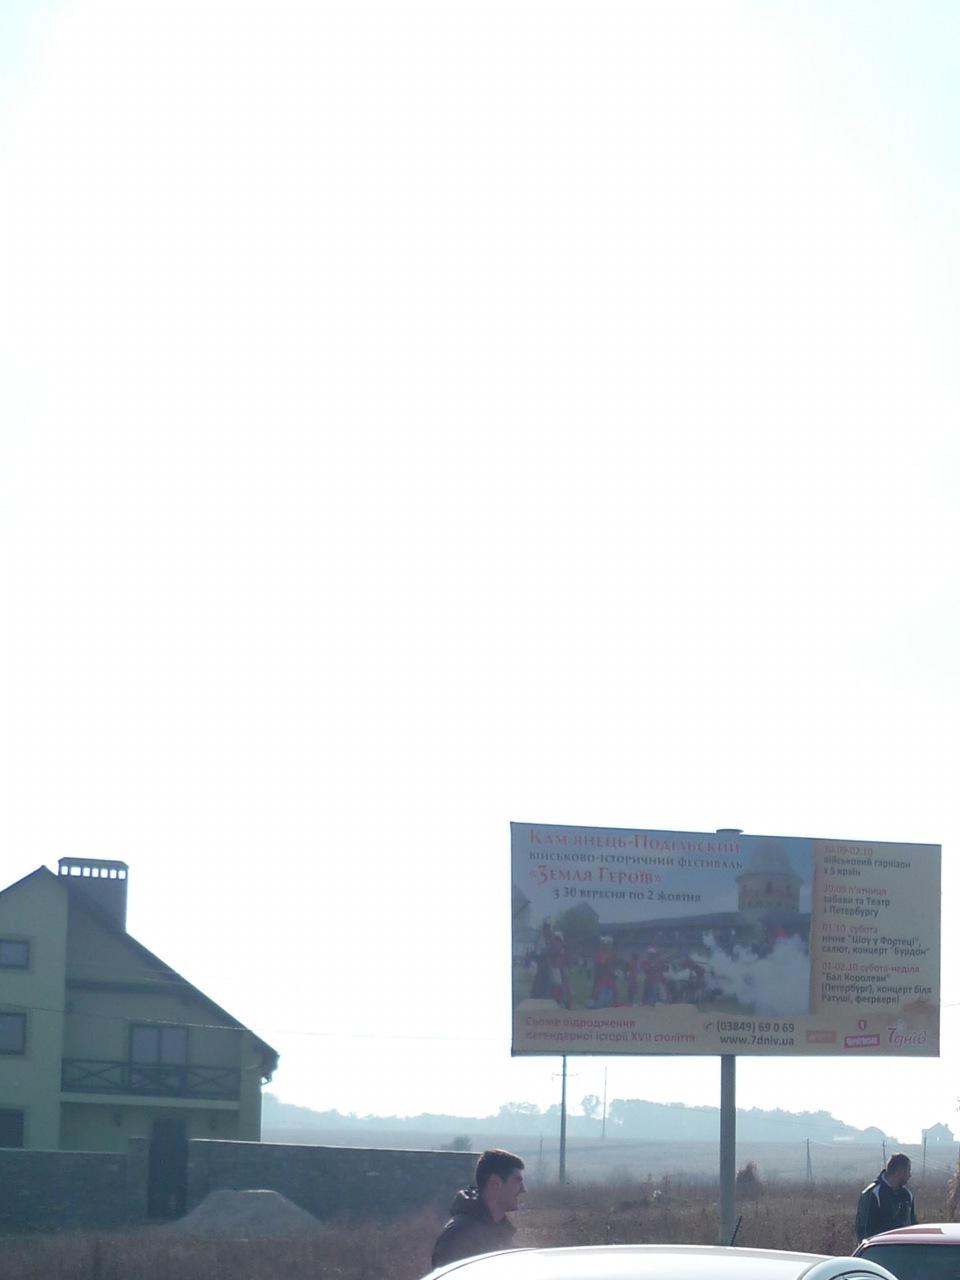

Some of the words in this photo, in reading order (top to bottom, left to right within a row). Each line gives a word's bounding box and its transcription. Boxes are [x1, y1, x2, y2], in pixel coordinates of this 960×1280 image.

[874, 859, 911, 870] гарнізон
[830, 867, 835, 875] 5
[837, 868, 861, 877] країн
[564, 887, 577, 898] 30
[628, 891, 644, 900] по
[647, 889, 654, 900] 2
[855, 897, 864, 905] та
[866, 896, 891, 908] Театр
[829, 905, 879, 918] Петербургу
[822, 924, 846, 932] 01.10
[849, 925, 878, 935] субота
[822, 935, 846, 943] нічне
[853, 946, 888, 957] концерт
[876, 986, 912, 995] концерт
[914, 985, 932, 994] біля
[716, 1021, 756, 1034] (03849)
[758, 1022, 771, 1033] 69
[773, 1022, 779, 1033] 0
[782, 1022, 795, 1034] 69
[596, 1032, 628, 1043] історії
[631, 1031, 651, 1042] XVII
[654, 1032, 695, 1043] століття
[719, 1034, 795, 1047] www.7dniv.ua
